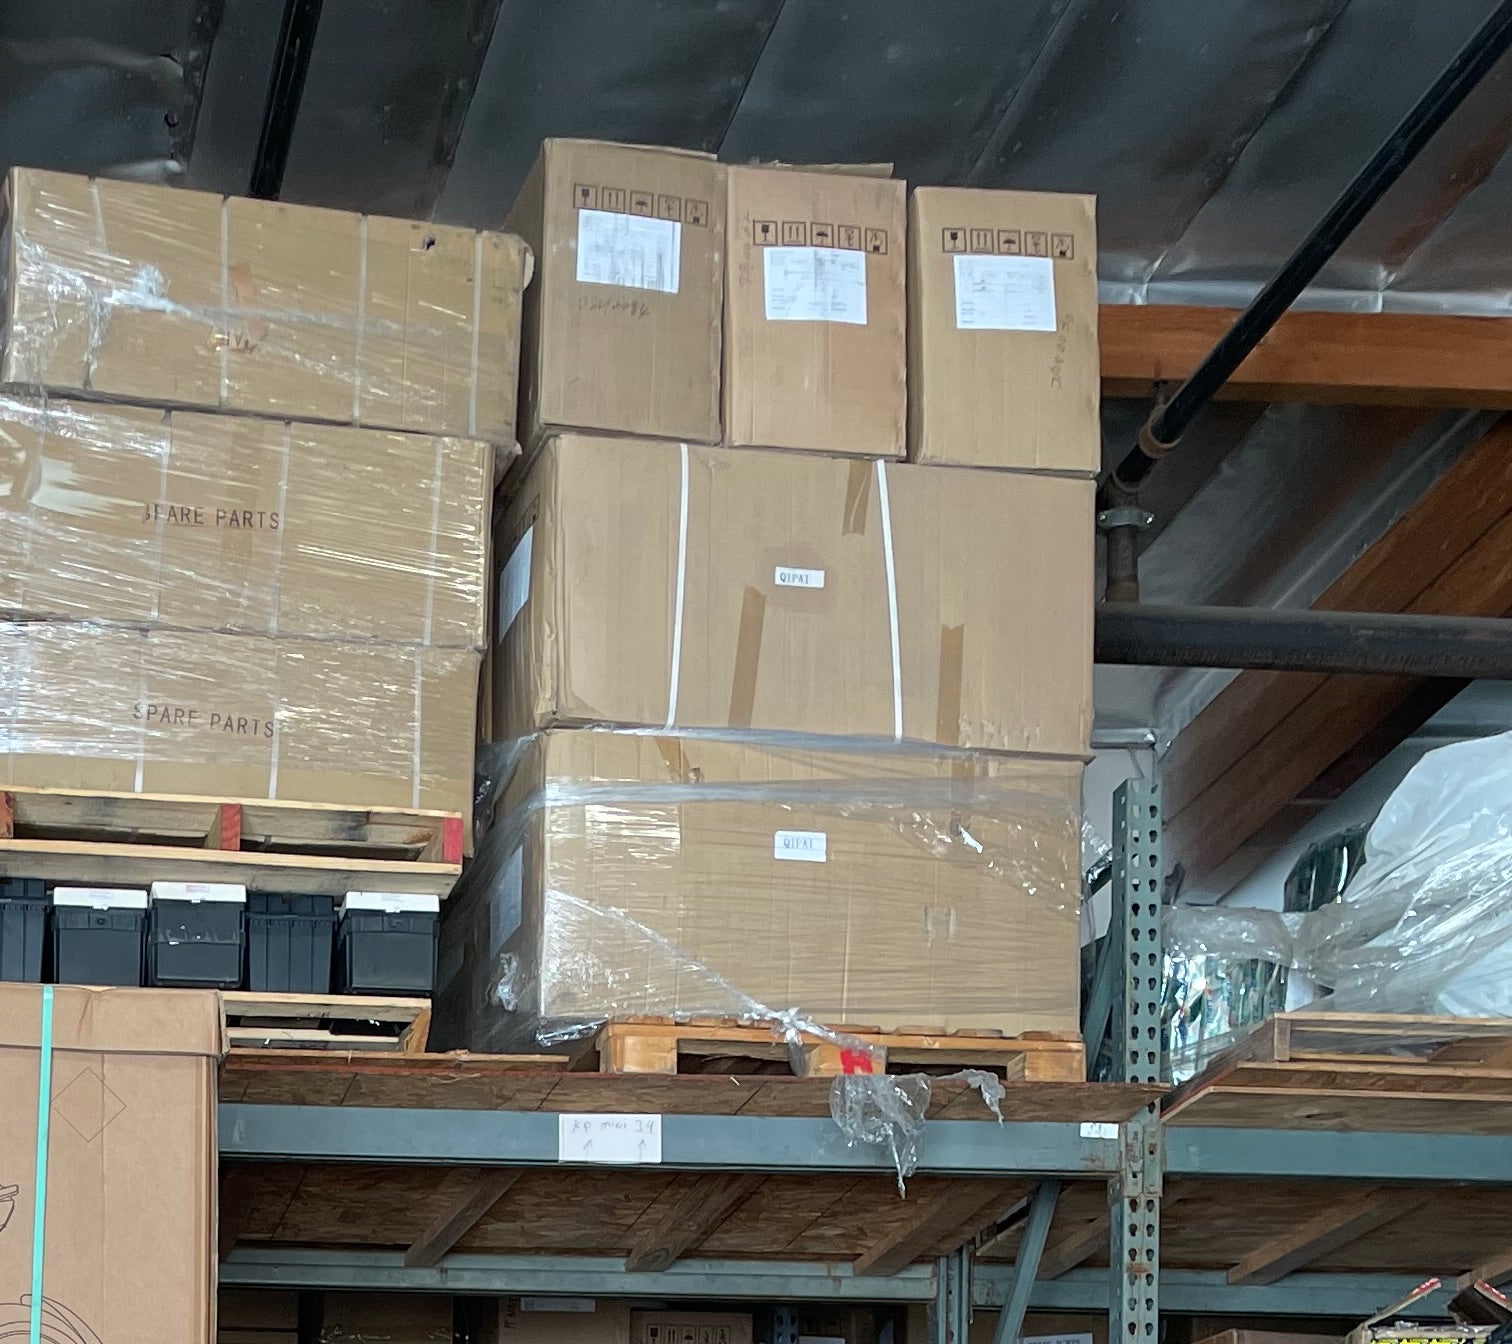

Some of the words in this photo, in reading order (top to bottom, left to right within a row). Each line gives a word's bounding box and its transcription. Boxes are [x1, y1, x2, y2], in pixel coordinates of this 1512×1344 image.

[217, 507, 281, 531] PARTS
[779, 572, 810, 585] QIPAI
[132, 702, 198, 727] SPARE
[210, 711, 275, 738] PARTS
[783, 837, 814, 851] QIPAI
